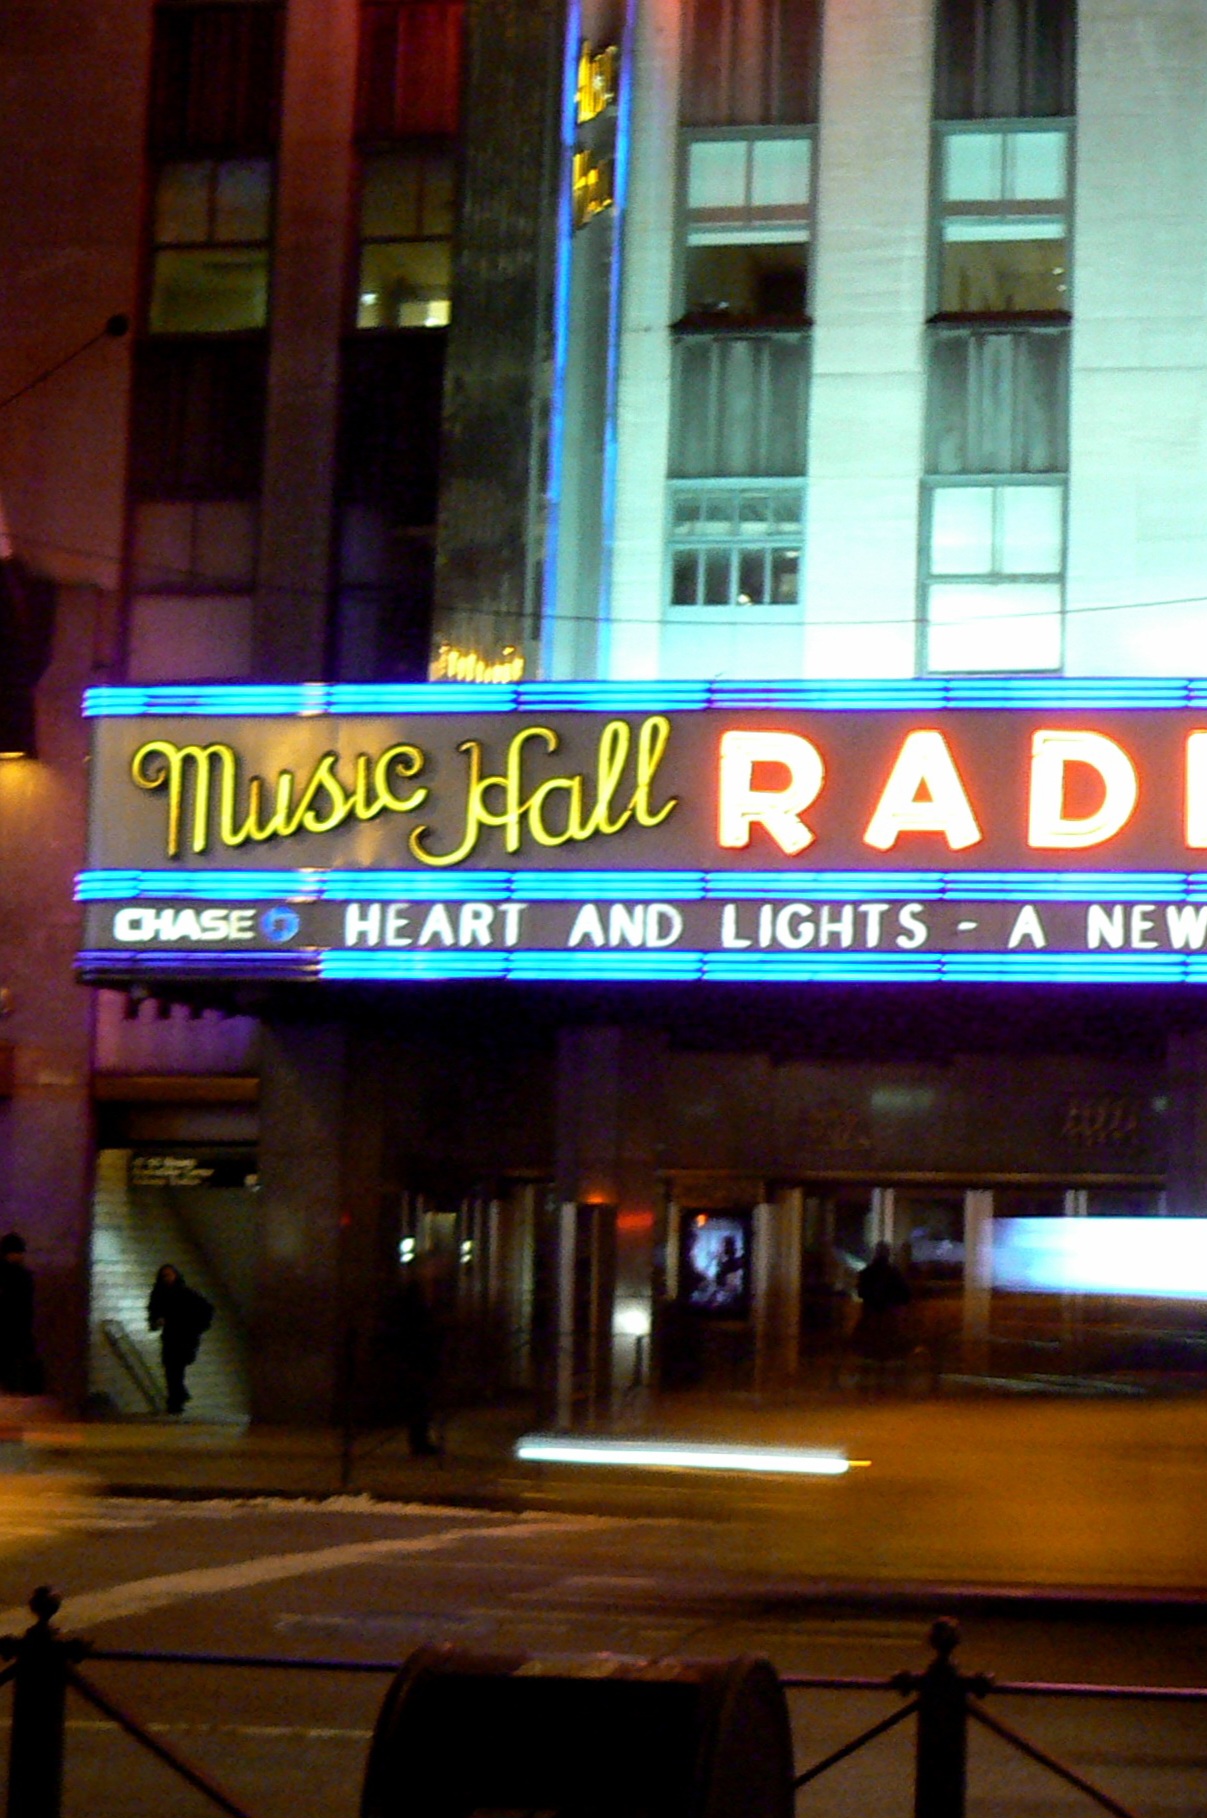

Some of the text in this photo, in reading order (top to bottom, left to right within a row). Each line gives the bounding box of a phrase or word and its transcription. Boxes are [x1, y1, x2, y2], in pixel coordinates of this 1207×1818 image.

[131, 714, 678, 867] Music Hall
[113, 905, 258, 943] CHASE
[345, 903, 527, 948] HEART
[567, 903, 684, 947] AND
[721, 903, 929, 950] LIGHTS
[1008, 904, 1047, 949] A
